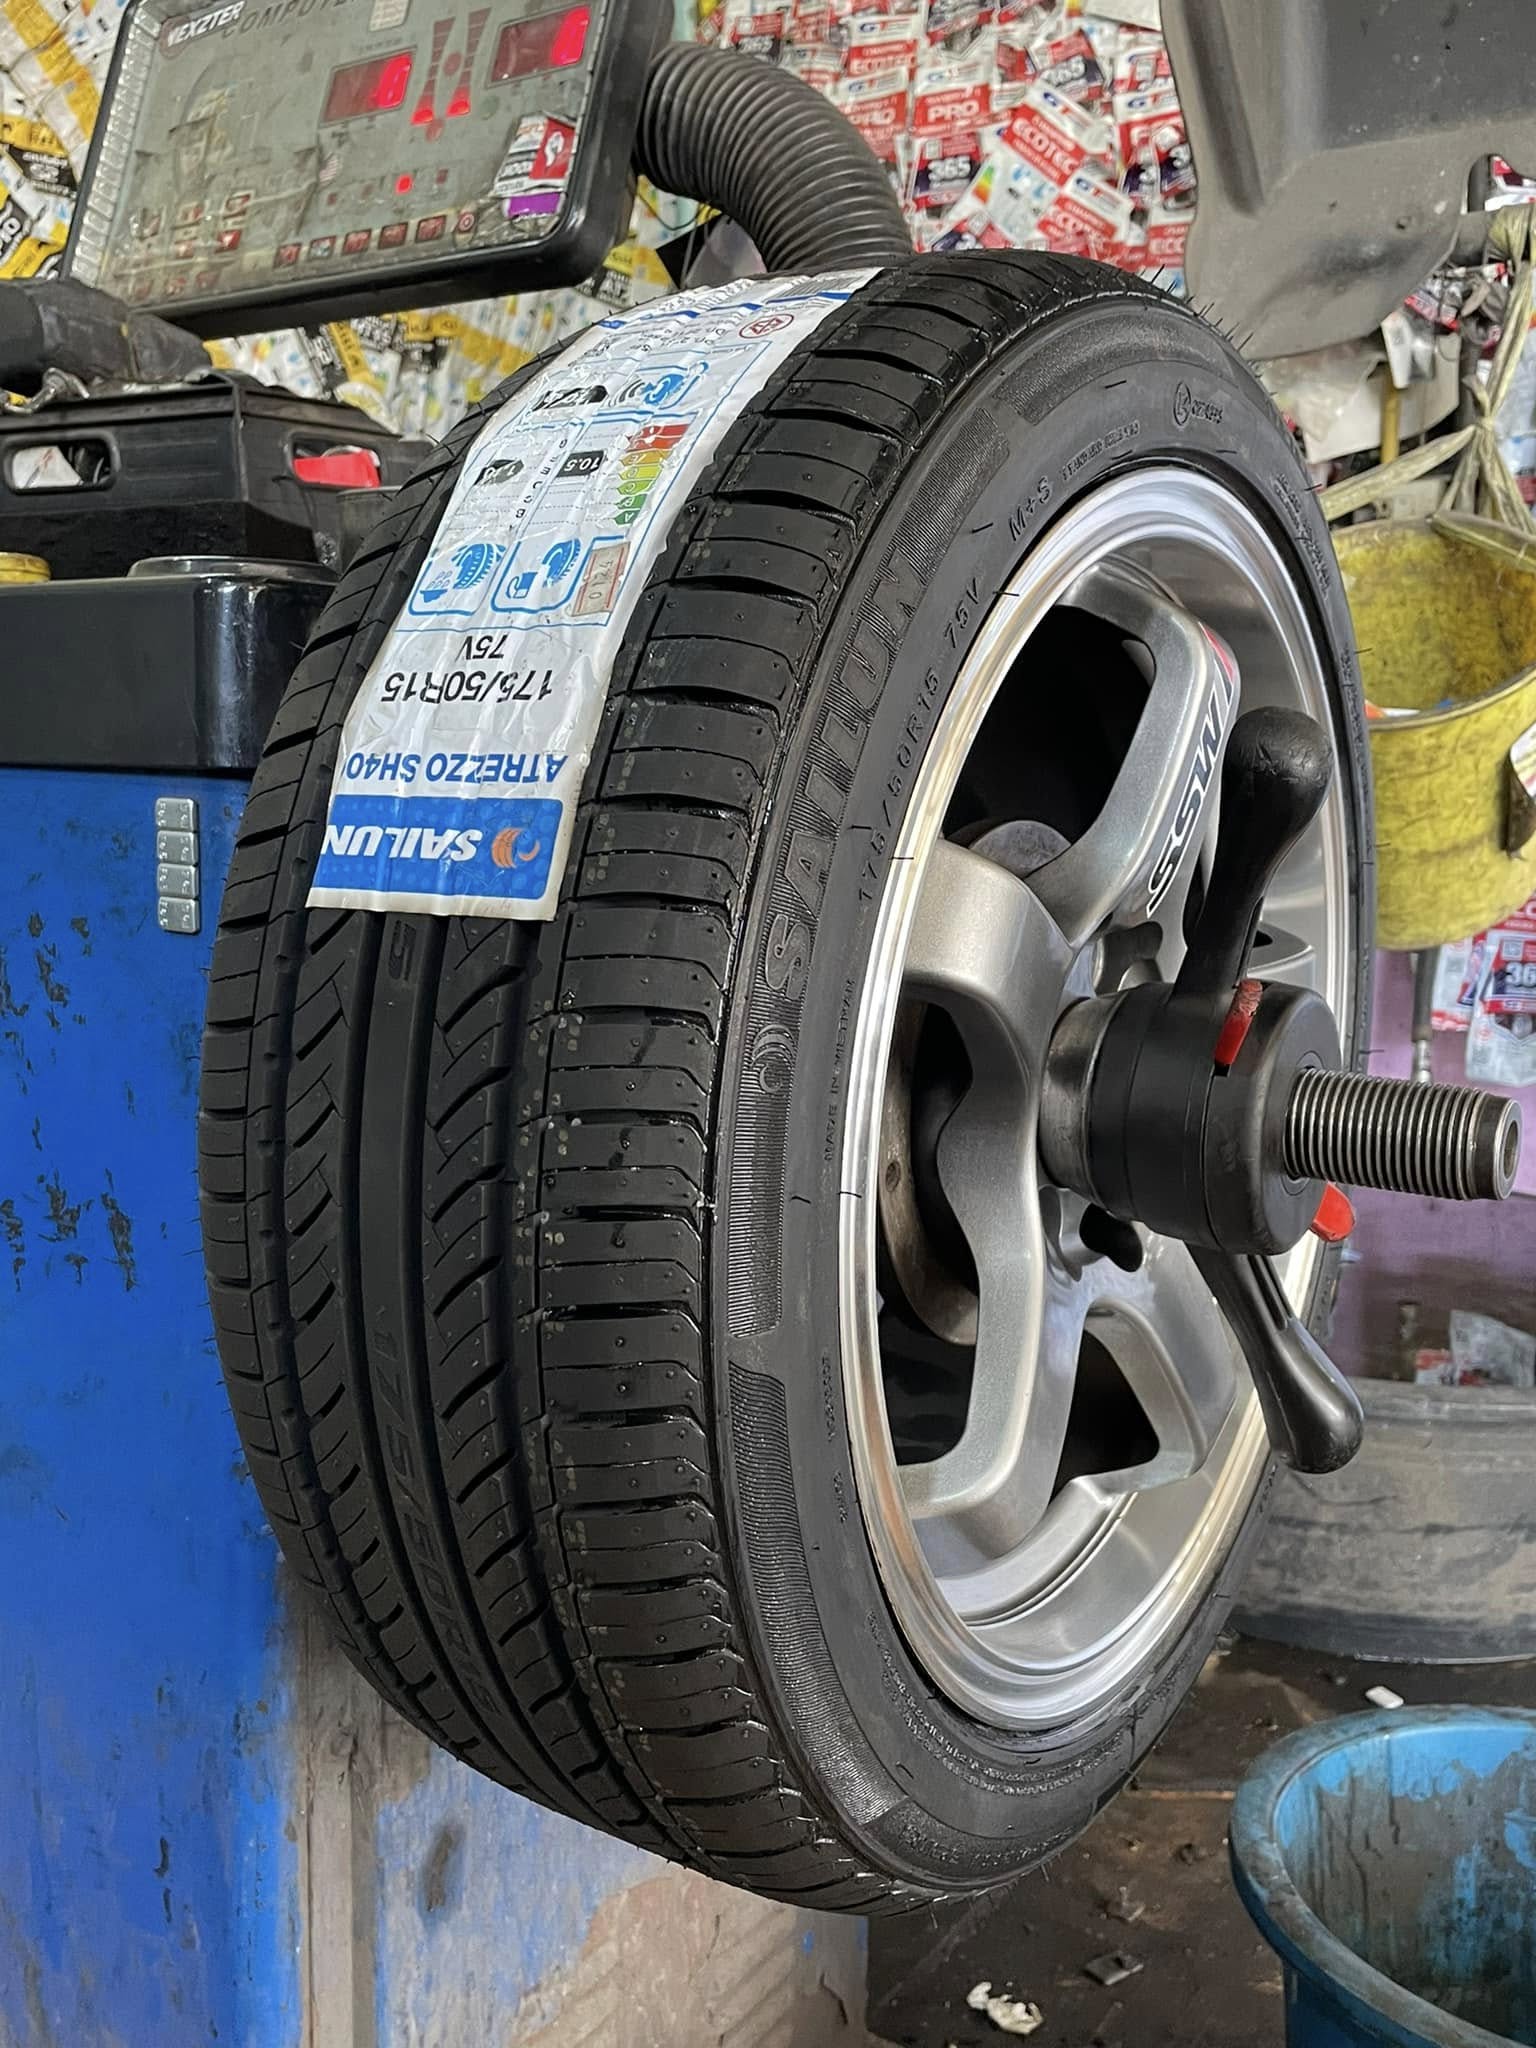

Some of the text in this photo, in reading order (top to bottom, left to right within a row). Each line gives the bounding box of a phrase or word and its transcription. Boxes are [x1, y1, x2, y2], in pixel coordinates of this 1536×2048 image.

[222, 0, 347, 38] COMPU
[927, 100, 979, 121] PRO
[1011, 117, 1080, 173] ECOTEC
[928, 155, 971, 182] 365
[564, 456, 600, 472] 10.5
[516, 508, 527, 518] B
[625, 512, 635, 523] A
[1009, 475, 1052, 542] M+S
[944, 577, 979, 649] 75V
[454, 635, 508, 663] 75V
[381, 670, 552, 703] 175/50R15
[425, 753, 568, 784] ATREZZO
[765, 553, 928, 1000] SAILUN
[859, 667, 939, 902] 175/50R15
[320, 824, 483, 862] SAILUN
